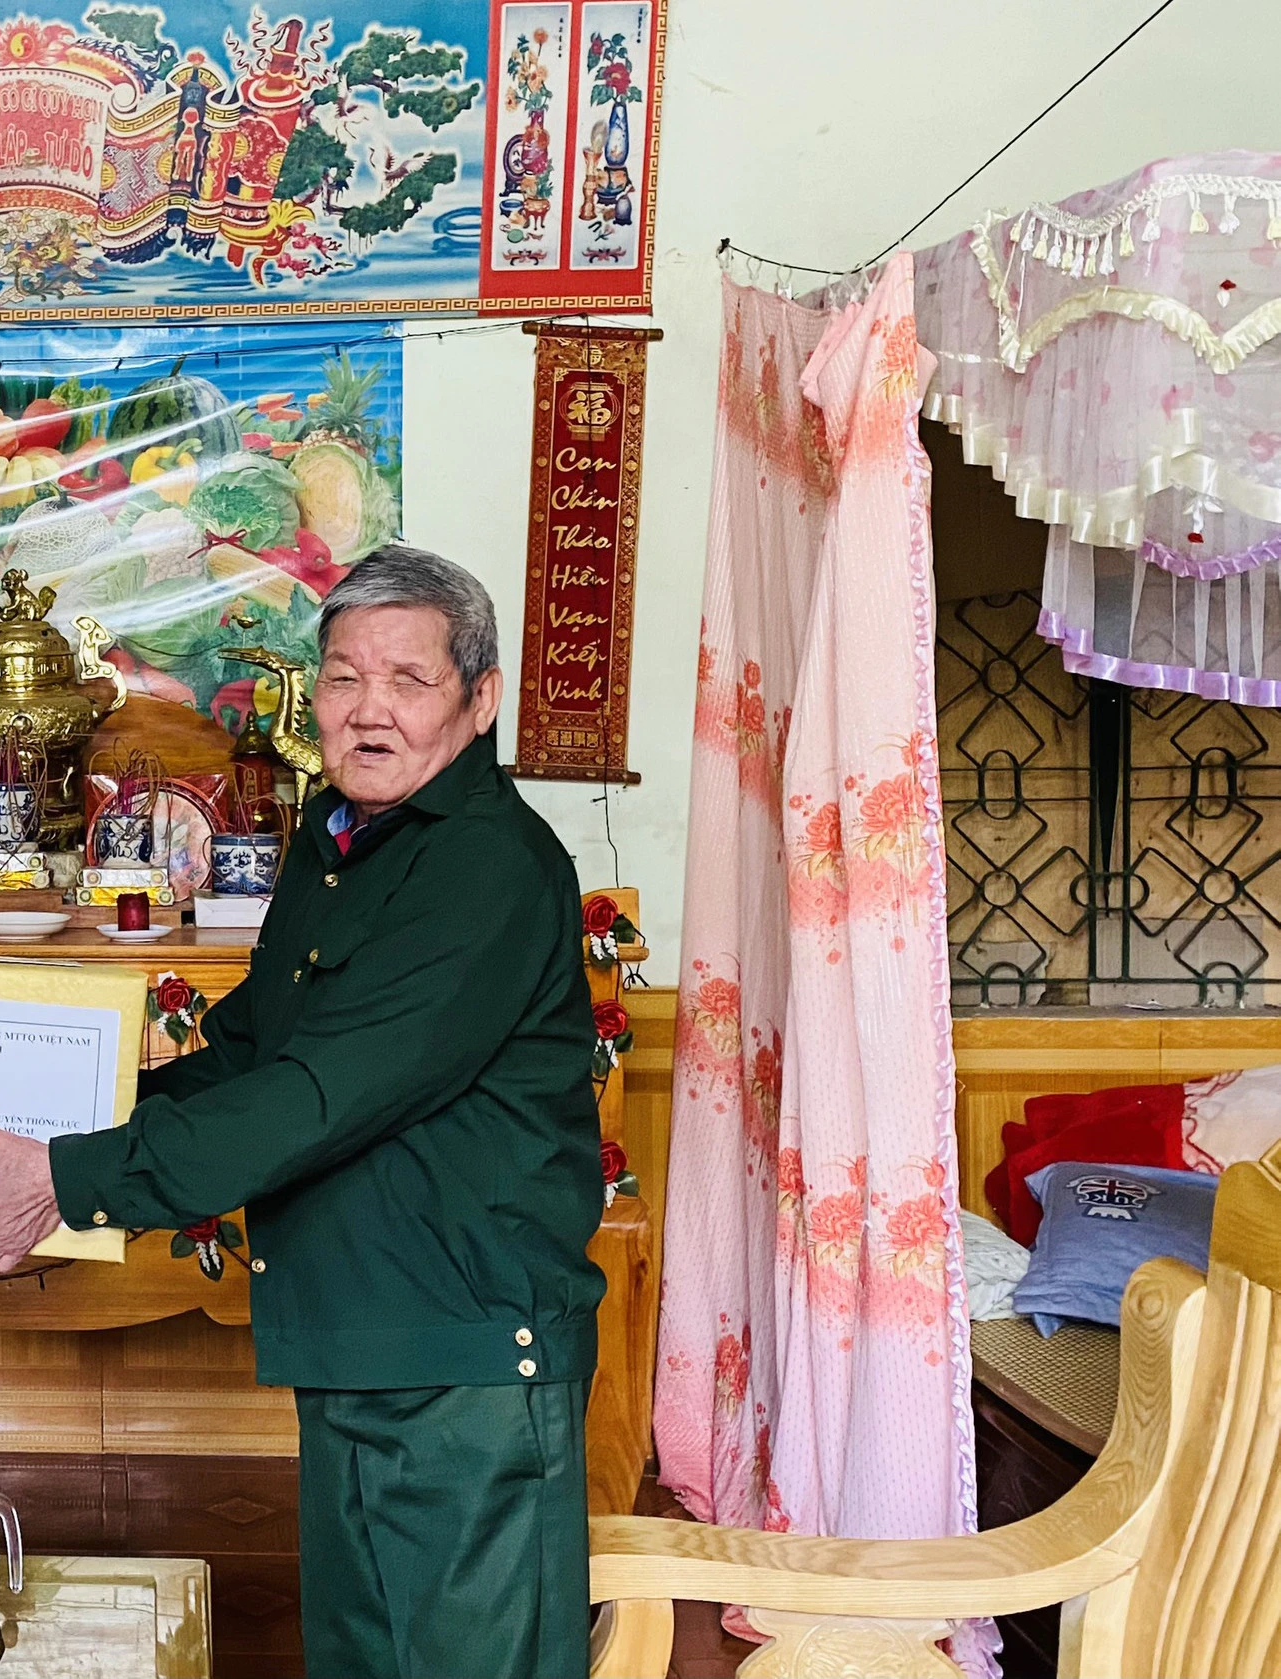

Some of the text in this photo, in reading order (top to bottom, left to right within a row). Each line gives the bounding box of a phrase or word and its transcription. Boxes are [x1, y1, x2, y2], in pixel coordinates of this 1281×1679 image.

[44, 128, 69, 177] TỰ
[70, 138, 94, 181] DO
[568, 391, 612, 424] 福
[555, 447, 617, 472] Con
[552, 524, 612, 551] Thảo
[551, 564, 609, 590] Hiền
[549, 602, 608, 632] Vạn
[546, 639, 607, 672] Kiếp
[547, 676, 602, 702] Vinh
[5, 1032, 36, 1043] MTTQ
[38, 1034, 64, 1045] VIỆT
[66, 1037, 91, 1047] NAM
[17, 1127, 35, 1136] CAI
[61, 1119, 81, 1130] LỰC
[1092, 1194, 1129, 1204] UK
